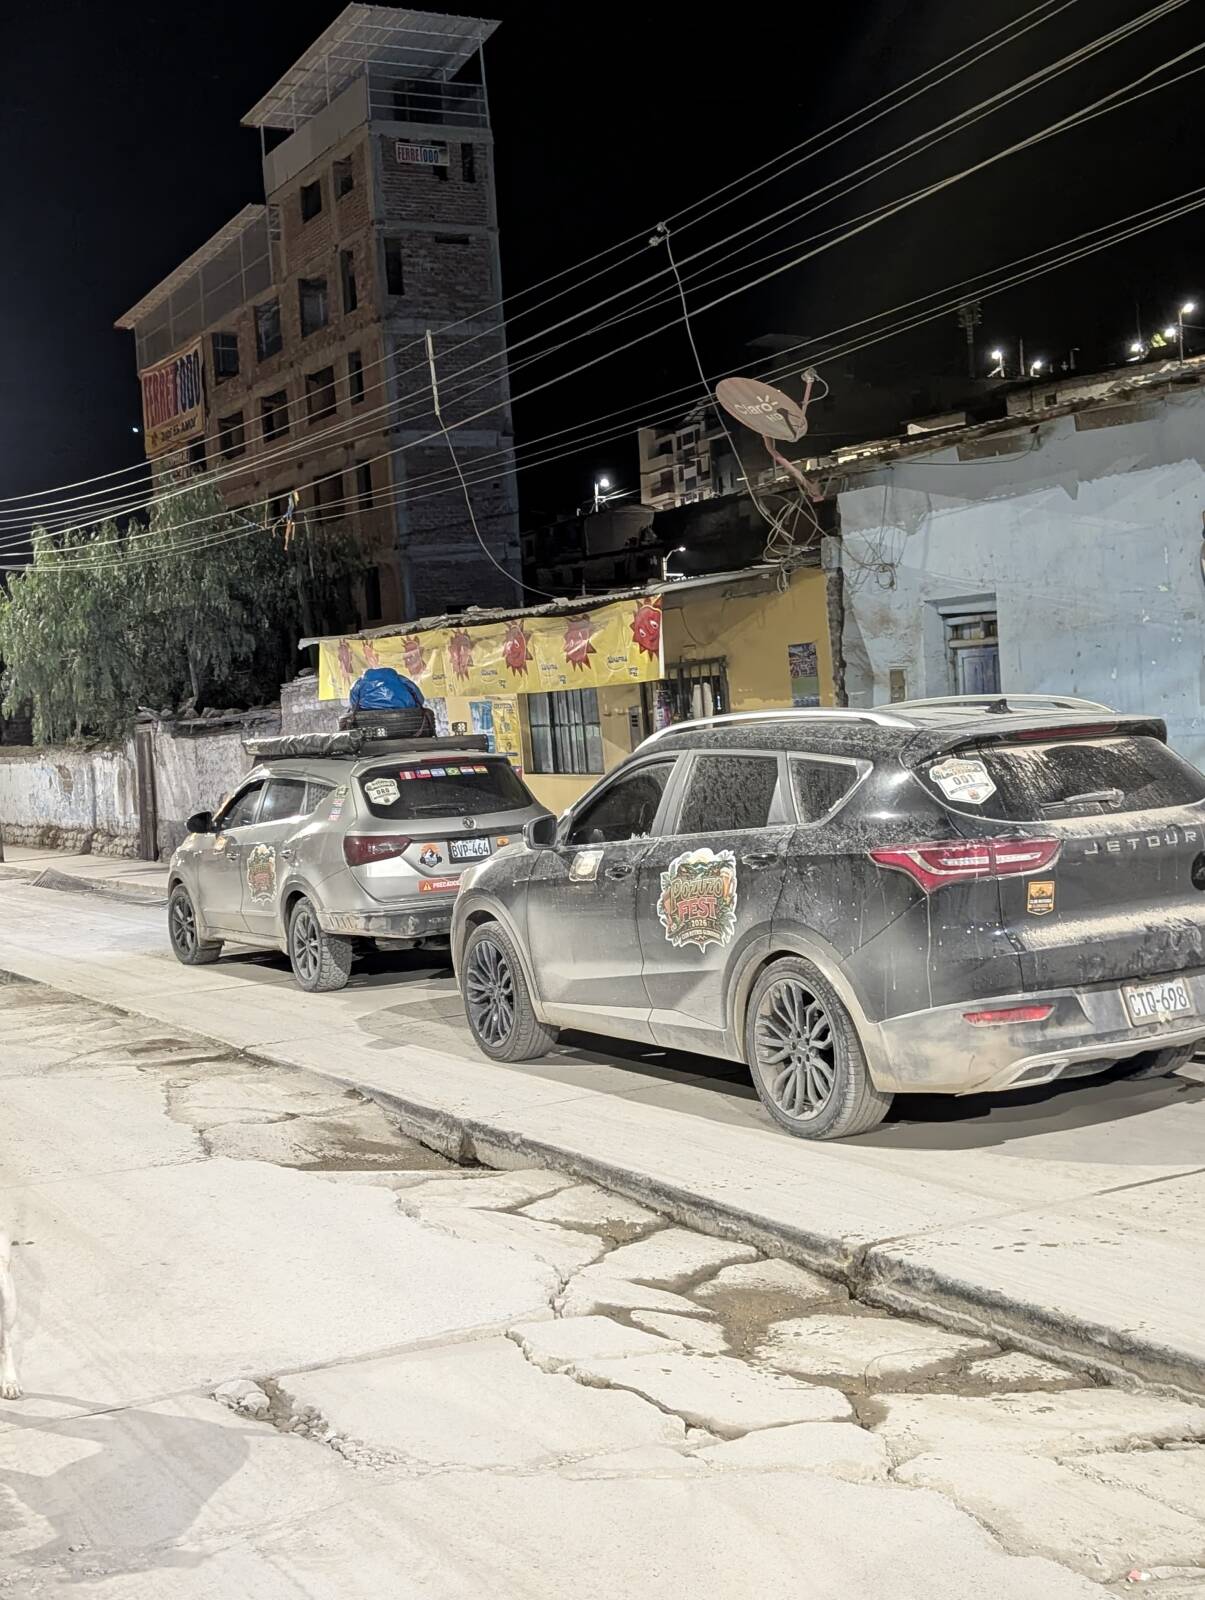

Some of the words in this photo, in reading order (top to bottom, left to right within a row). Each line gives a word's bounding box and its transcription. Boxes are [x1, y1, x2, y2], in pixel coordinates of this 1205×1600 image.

[734, 403, 773, 415] Claro
[766, 413, 784, 423] HD
[451, 842, 489, 858] BVP-464
[1084, 831, 1197, 855] JETOUR
[670, 878, 724, 914] POZUZO
[677, 897, 717, 921] FEST
[1128, 985, 1188, 1017] CTQ-698
